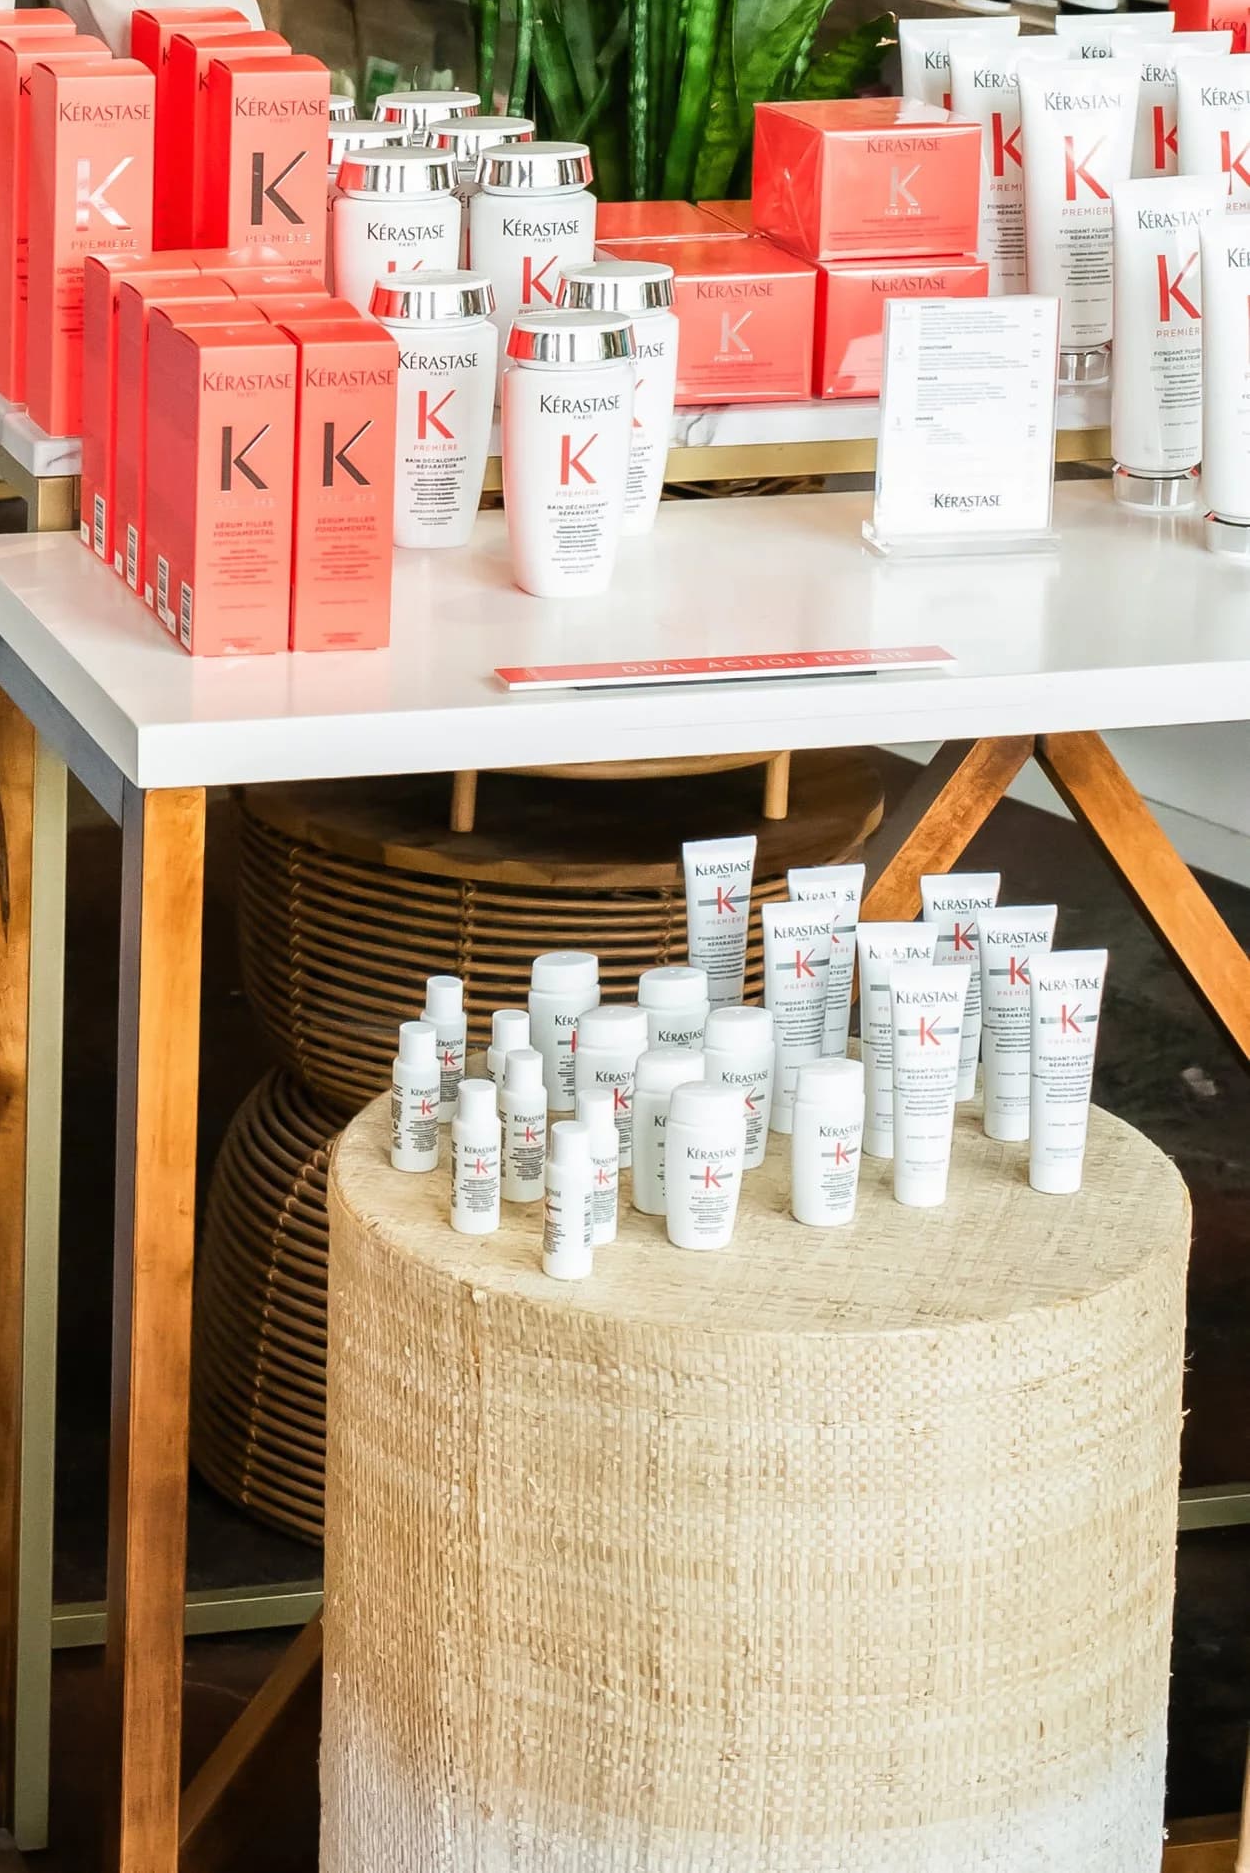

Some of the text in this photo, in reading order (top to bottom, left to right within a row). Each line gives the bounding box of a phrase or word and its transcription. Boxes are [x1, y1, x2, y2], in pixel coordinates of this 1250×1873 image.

[973, 69, 1020, 88] KÉRAS
[58, 101, 151, 123] KÉRASTASE
[234, 95, 327, 117] KÉRASTASE
[1043, 91, 1123, 112] KÉRASTASE
[991, 112, 1023, 177] K
[1064, 135, 1111, 201] K
[74, 156, 135, 233] K
[250, 150, 310, 226] K
[889, 164, 921, 207] K
[989, 183, 1023, 192] PREMI
[367, 222, 445, 241] KÉRASTASE
[502, 217, 580, 238] KÉRASTASE
[522, 255, 559, 305] K
[696, 281, 774, 299] KÉRASTASE
[1156, 251, 1203, 323] K
[720, 310, 753, 352] K
[397, 350, 479, 370] KÉRASTASE
[202, 371, 293, 393] KÉRASTASE
[304, 366, 395, 388] KÉRASTASE
[417, 389, 456, 440] K
[539, 393, 621, 415] KÉRASTASE
[220, 423, 271, 492] K
[322, 419, 373, 488] K
[559, 433, 599, 486] K
[933, 492, 1002, 509] KÉRASTASE
[620, 649, 913, 674] DUAL ACTION REPAIR
[695, 859, 751, 877] KÉRASTASE
[716, 885, 738, 915] K
[933, 897, 993, 911] KÉRASTASE
[773, 923, 831, 939] KÉRASTASE
[954, 922, 975, 951] K
[986, 930, 1049, 945] KÉRASTASE
[796, 949, 816, 979] K
[1010, 956, 1031, 985] K
[896, 990, 960, 1005] KÉRASTASE
[1061, 1003, 1083, 1034] K
[919, 1015, 941, 1047] K
[444, 1050, 456, 1067] K
[595, 1070, 635, 1084] KÉRASTA
[421, 1099, 433, 1116] K
[613, 1087, 630, 1111] K
[525, 1125, 538, 1143] K
[835, 1140, 851, 1166] K
[475, 1158, 489, 1175] K
[598, 1168, 610, 1186] K
[704, 1164, 723, 1189] K
